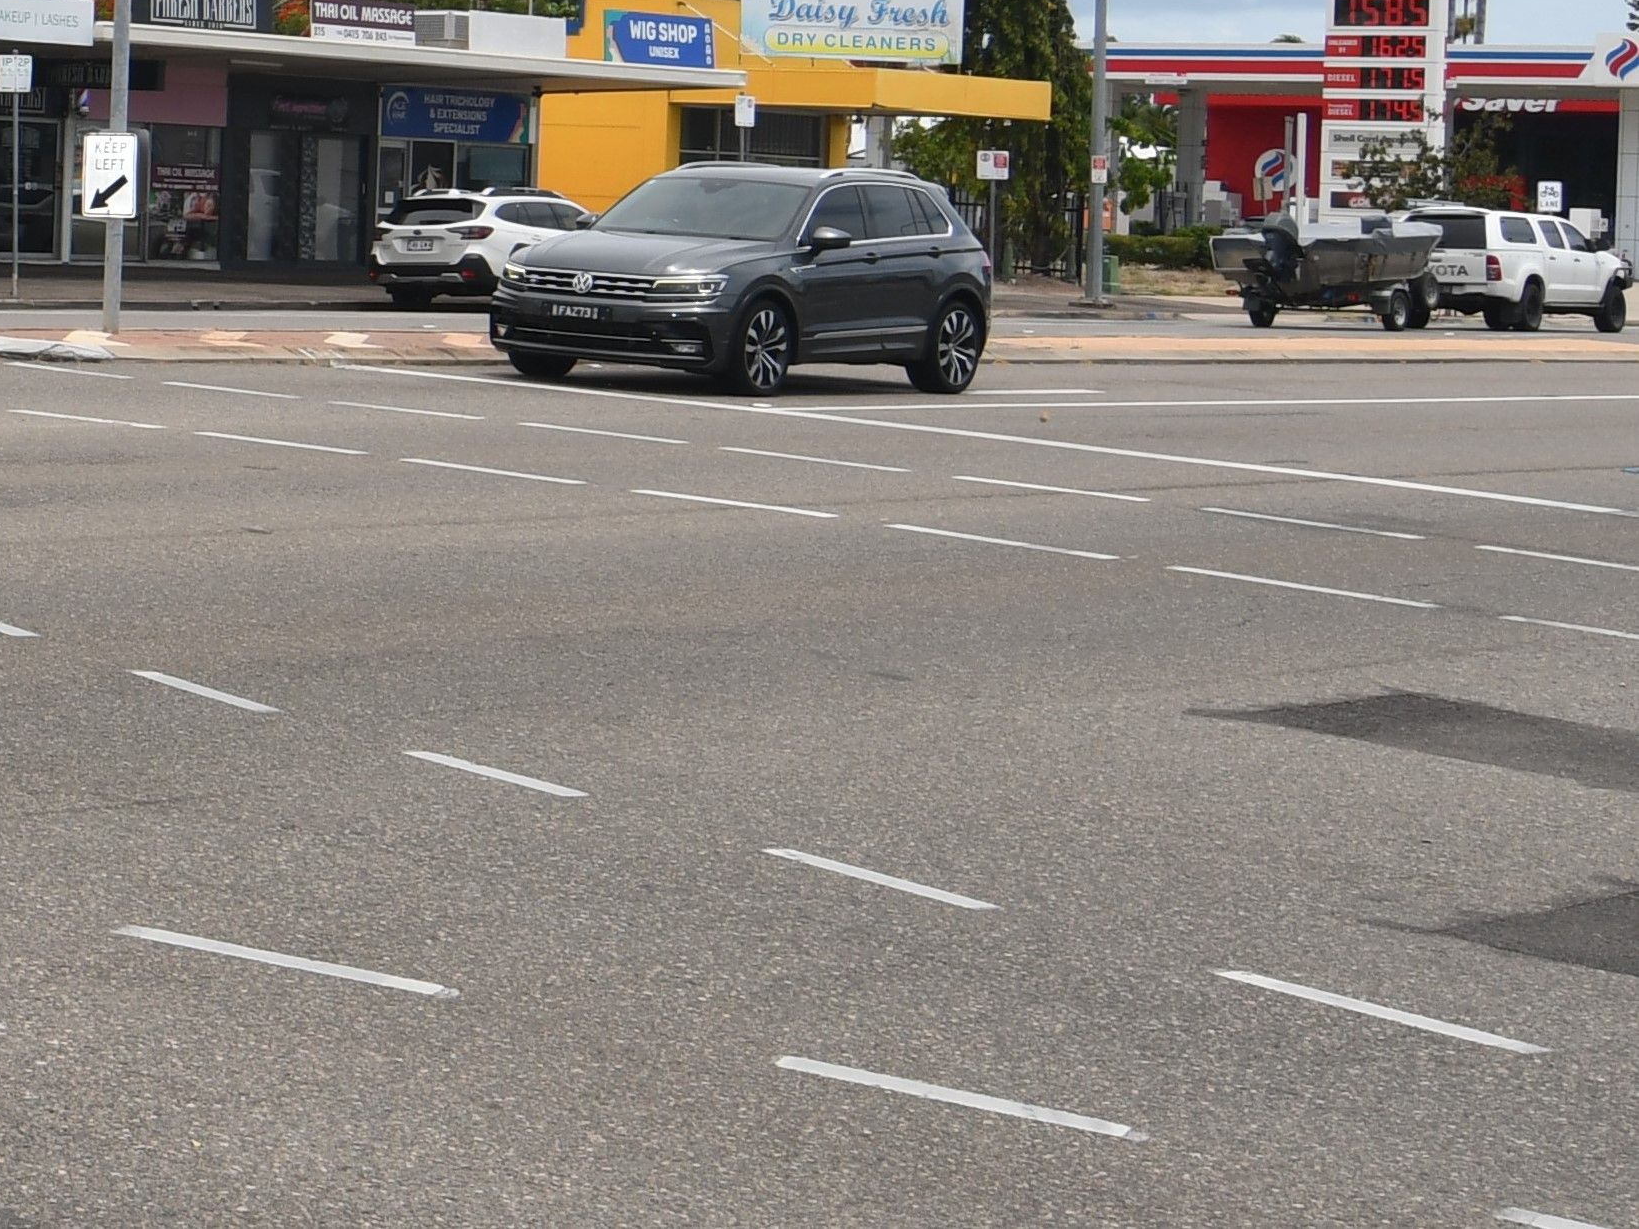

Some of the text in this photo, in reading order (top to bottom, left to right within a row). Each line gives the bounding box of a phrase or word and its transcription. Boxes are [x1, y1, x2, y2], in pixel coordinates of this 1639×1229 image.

[314, 2, 413, 26] THAI OIL MASSAGE
[41, 13, 79, 28] LASHES
[629, 19, 657, 41] WIG
[658, 22, 698, 44] SHOP
[777, 32, 936, 52] DRY CLEANERS
[649, 45, 680, 59] UNISEX
[1327, 74, 1355, 82] DIESEL
[433, 123, 481, 135] SPECIALIST
[1333, 134, 1355, 142] Shell
[95, 142, 127, 154] KEEP
[95, 159, 126, 170] LEFT
[1539, 200, 1559, 208] LANE
